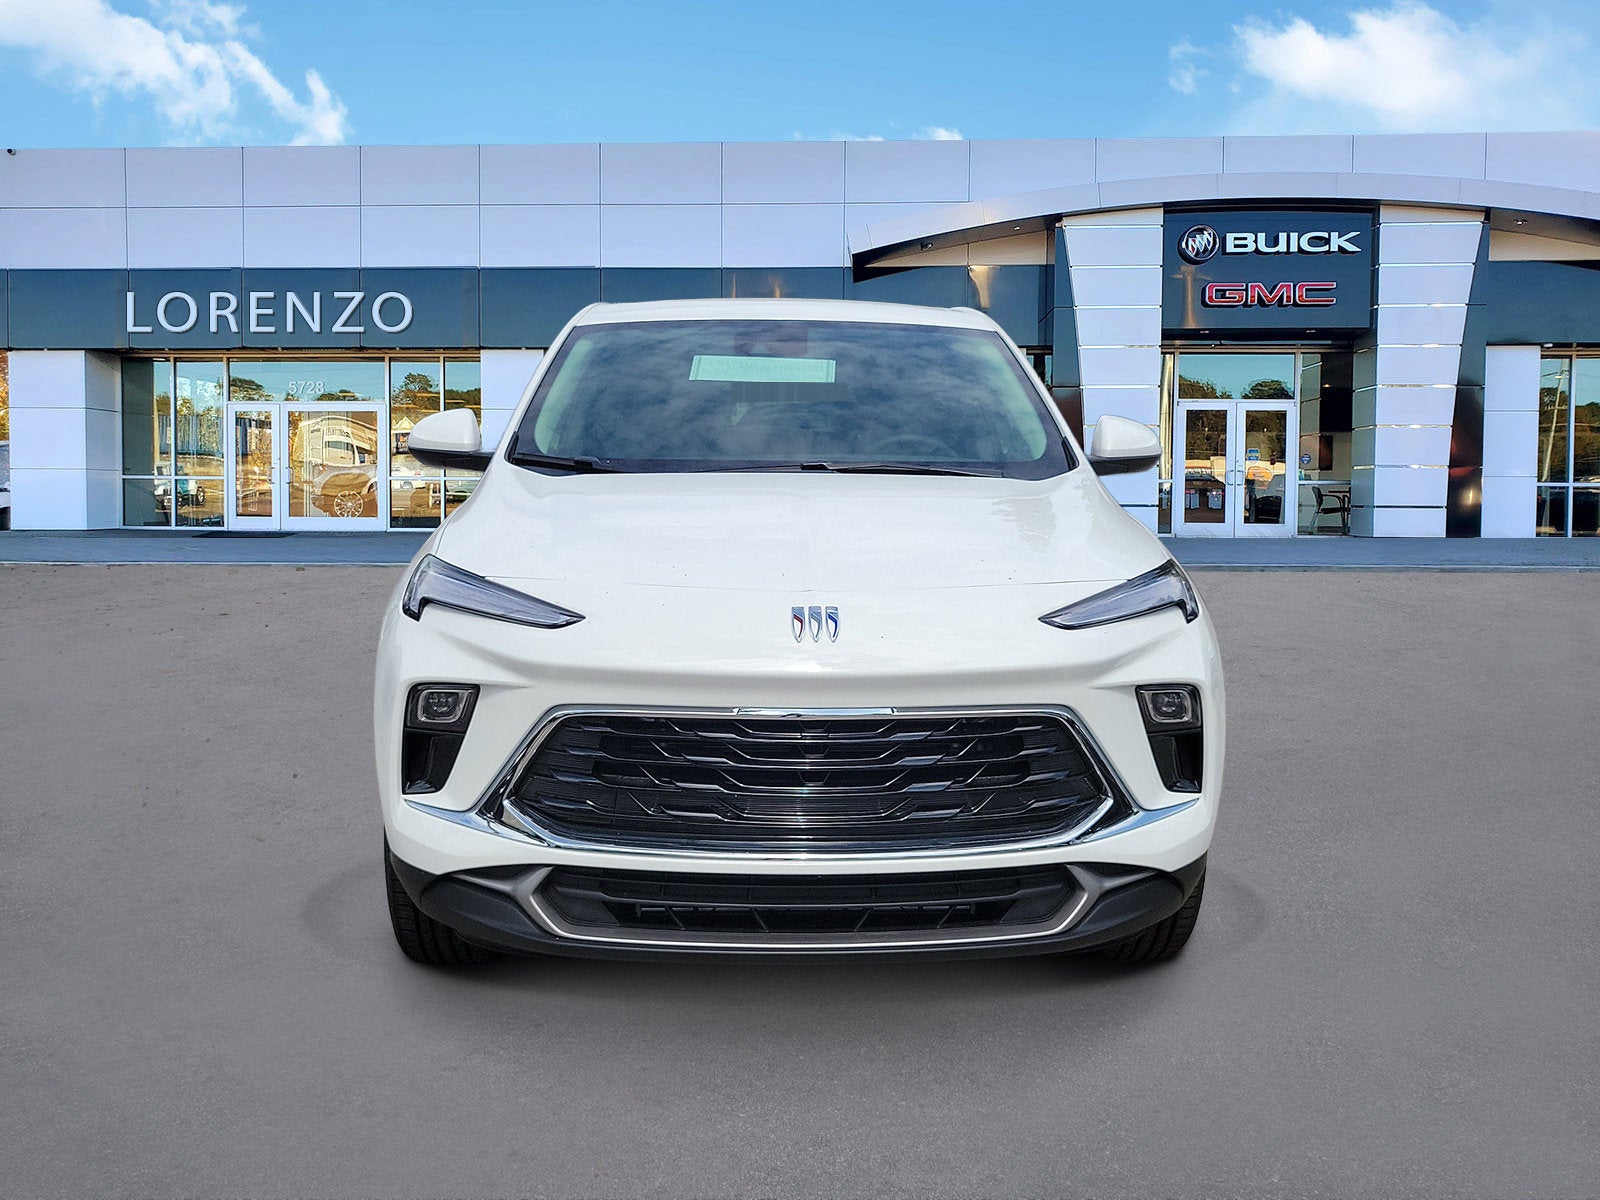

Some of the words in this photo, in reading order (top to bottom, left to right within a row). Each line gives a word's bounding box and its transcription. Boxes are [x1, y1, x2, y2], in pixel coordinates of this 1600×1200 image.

[1224, 231, 1362, 254] BUICK
[1205, 281, 1337, 305] GMC
[126, 291, 414, 333] LORENZO
[288, 380, 325, 394] 5728
